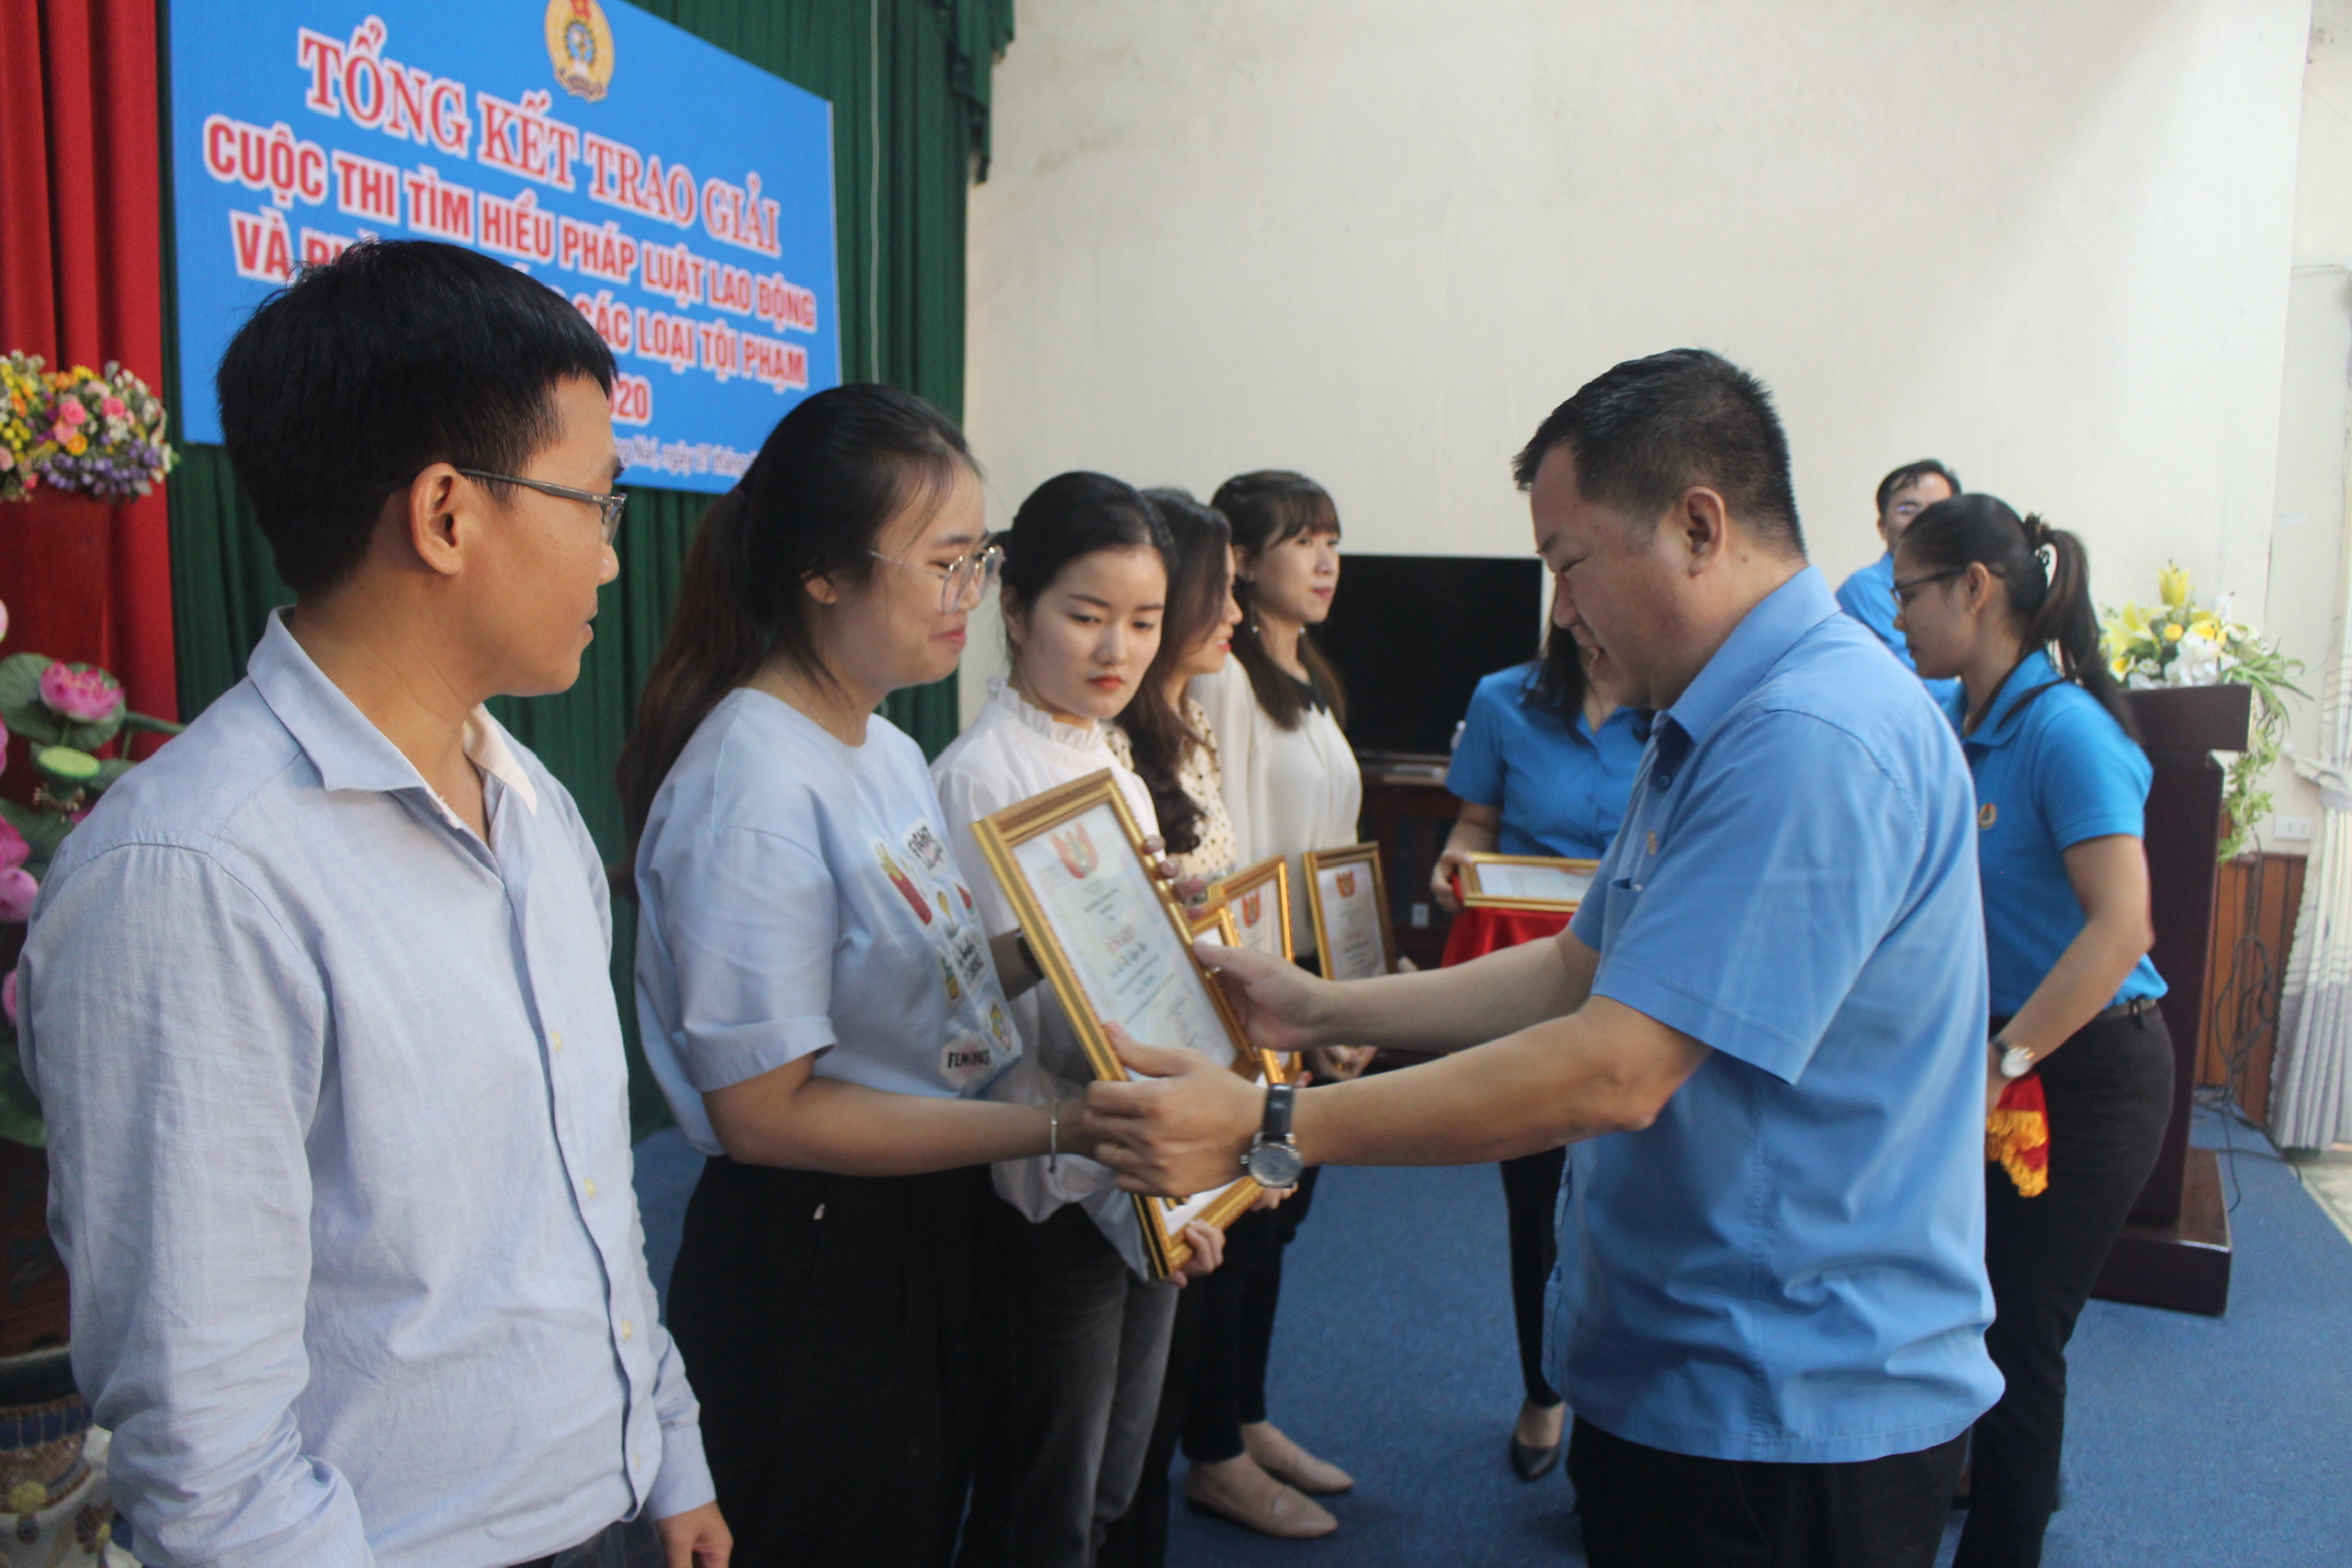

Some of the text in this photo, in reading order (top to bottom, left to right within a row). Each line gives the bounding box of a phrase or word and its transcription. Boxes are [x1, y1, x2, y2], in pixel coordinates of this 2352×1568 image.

[205, 118, 815, 331] CUỘC THI TÌM HIỂU PHÁP LUẬT LAO ĐỘNG
[301, 19, 779, 254] TỔNG KẾT TRAO GIẢI
[232, 211, 292, 279] VÀ
[637, 311, 695, 370] LOẠI
[698, 321, 737, 379] TỘI
[742, 336, 808, 392] PHẠM
[609, 378, 650, 423] 20
